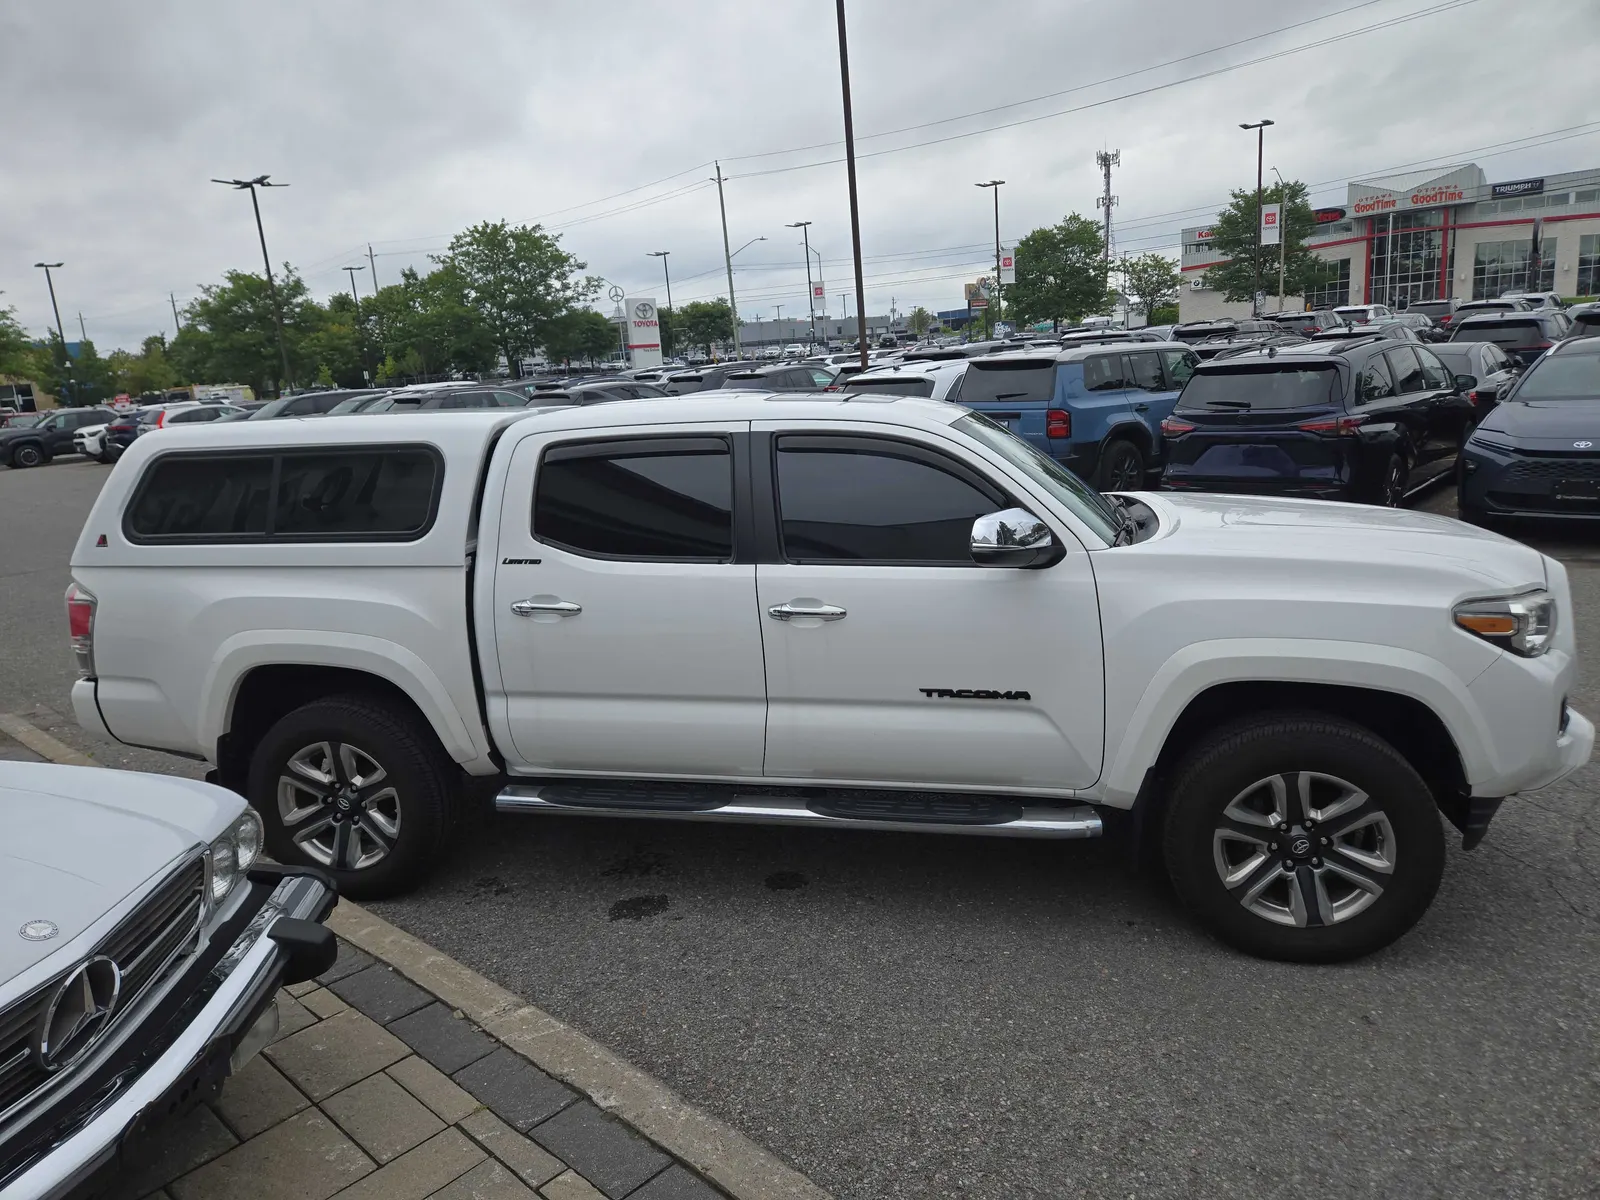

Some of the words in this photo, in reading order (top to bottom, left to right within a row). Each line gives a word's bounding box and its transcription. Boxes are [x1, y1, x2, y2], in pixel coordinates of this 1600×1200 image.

[1417, 185, 1458, 193] OTTAWA
[1495, 183, 1532, 193] TRIUMPH
[1359, 194, 1392, 203] OTTAWA
[1411, 191, 1463, 204] GoodTime
[632, 320, 659, 328] TOYOTA
[919, 688, 1031, 700] TACOMA
